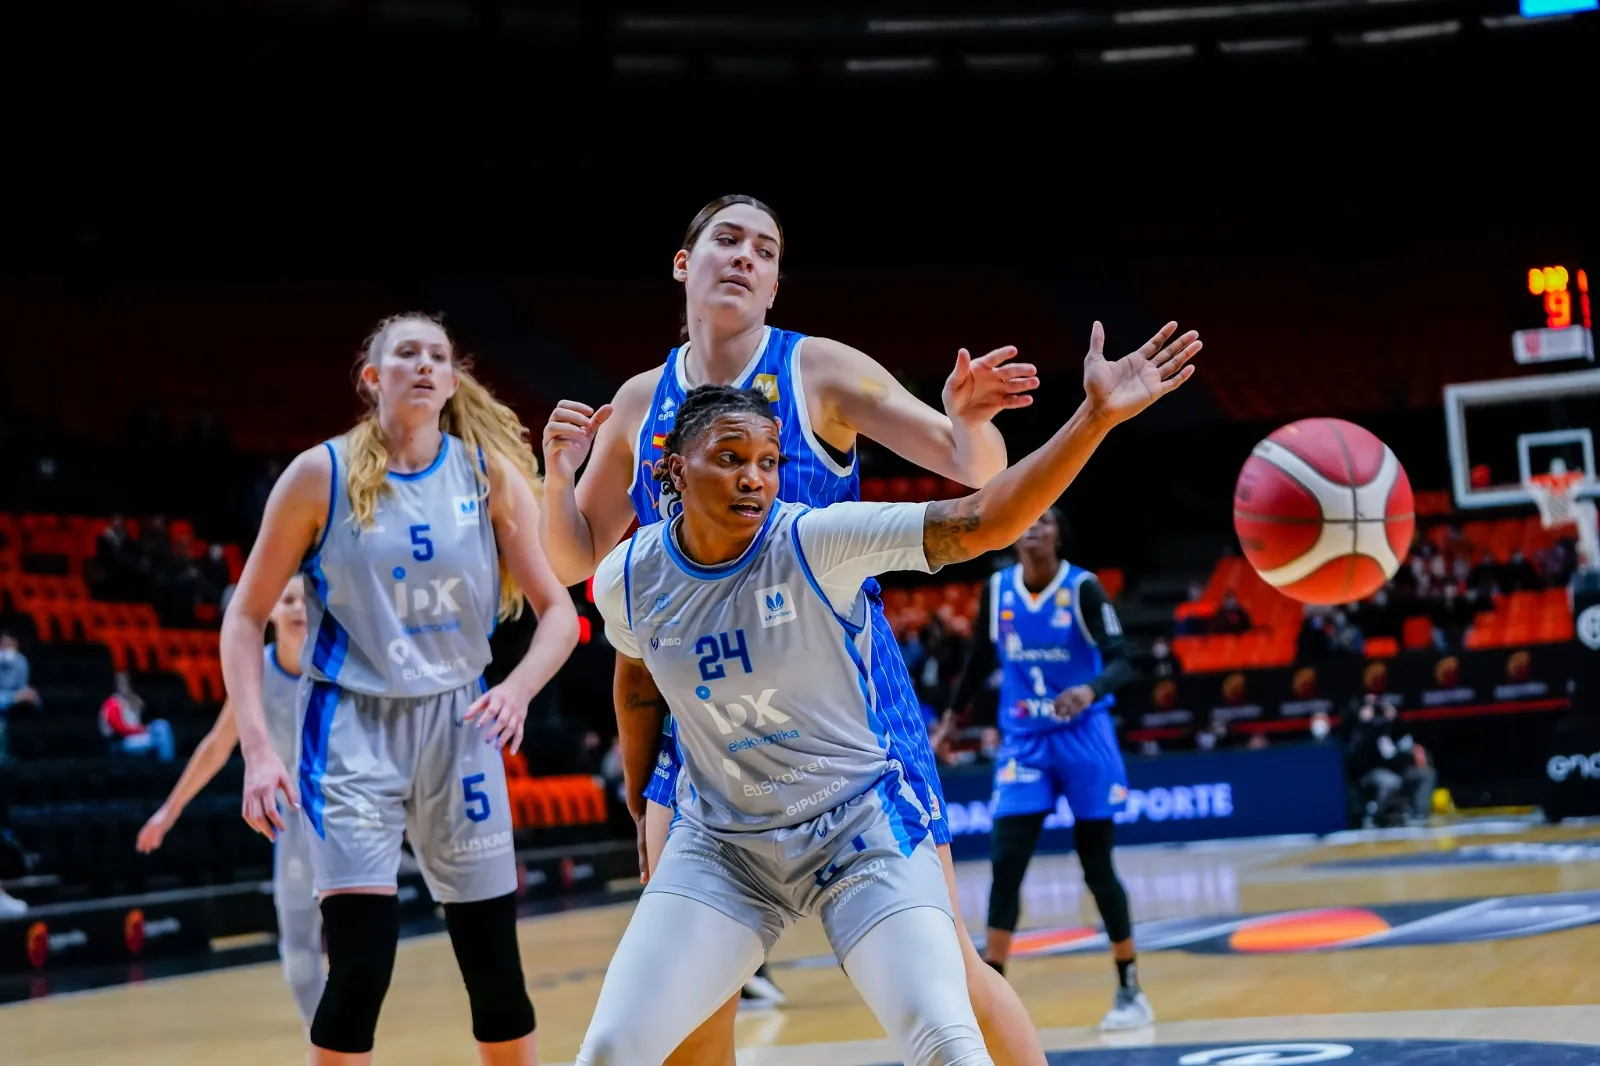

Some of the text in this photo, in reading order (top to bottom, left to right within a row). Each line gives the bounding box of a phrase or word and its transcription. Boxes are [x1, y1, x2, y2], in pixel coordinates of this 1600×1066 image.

[409, 524, 434, 562] 5
[696, 628, 753, 682] 24
[743, 756, 832, 797] euskotren
[786, 776, 850, 817] GIPUZKOA
[462, 773, 491, 823] 5
